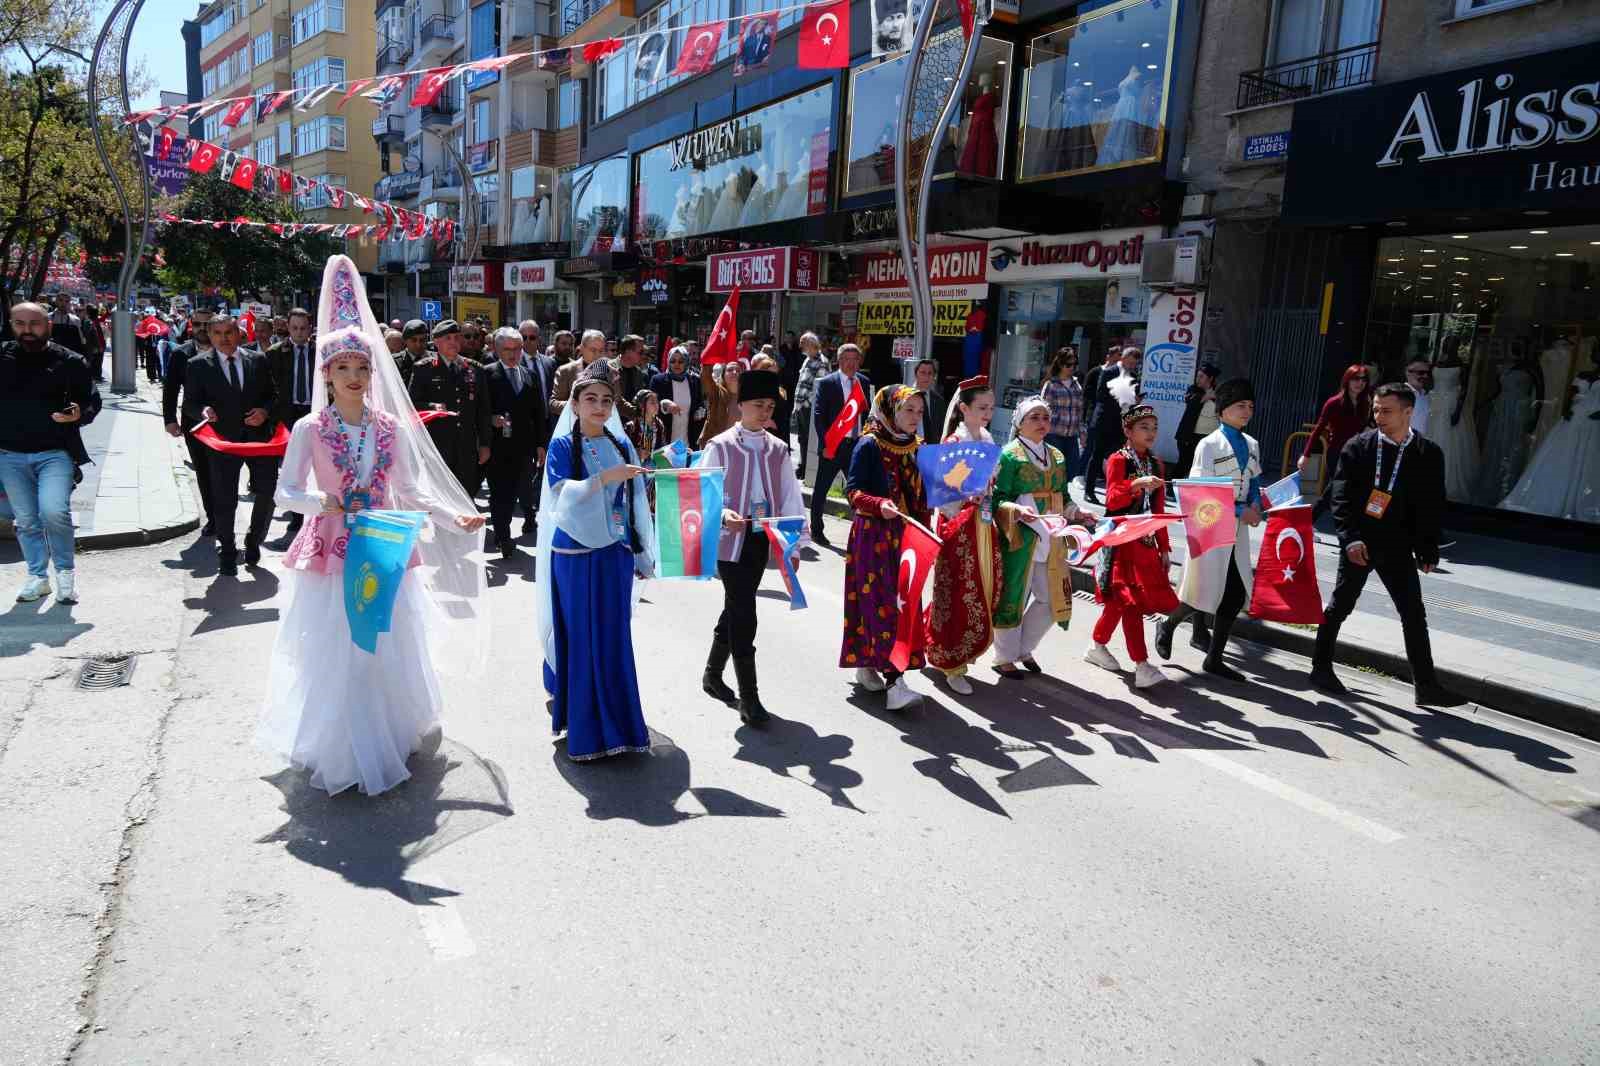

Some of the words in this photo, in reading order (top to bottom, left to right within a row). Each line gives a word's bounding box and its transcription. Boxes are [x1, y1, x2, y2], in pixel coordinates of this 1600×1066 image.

[1528, 161, 1600, 191] Hau
[717, 256, 743, 287] BÜFE
[751, 254, 776, 285] 1965
[867, 256, 919, 282] MEHM
[929, 250, 981, 279] AYDIN
[425, 302, 436, 317] P
[1148, 351, 1175, 374] SG
